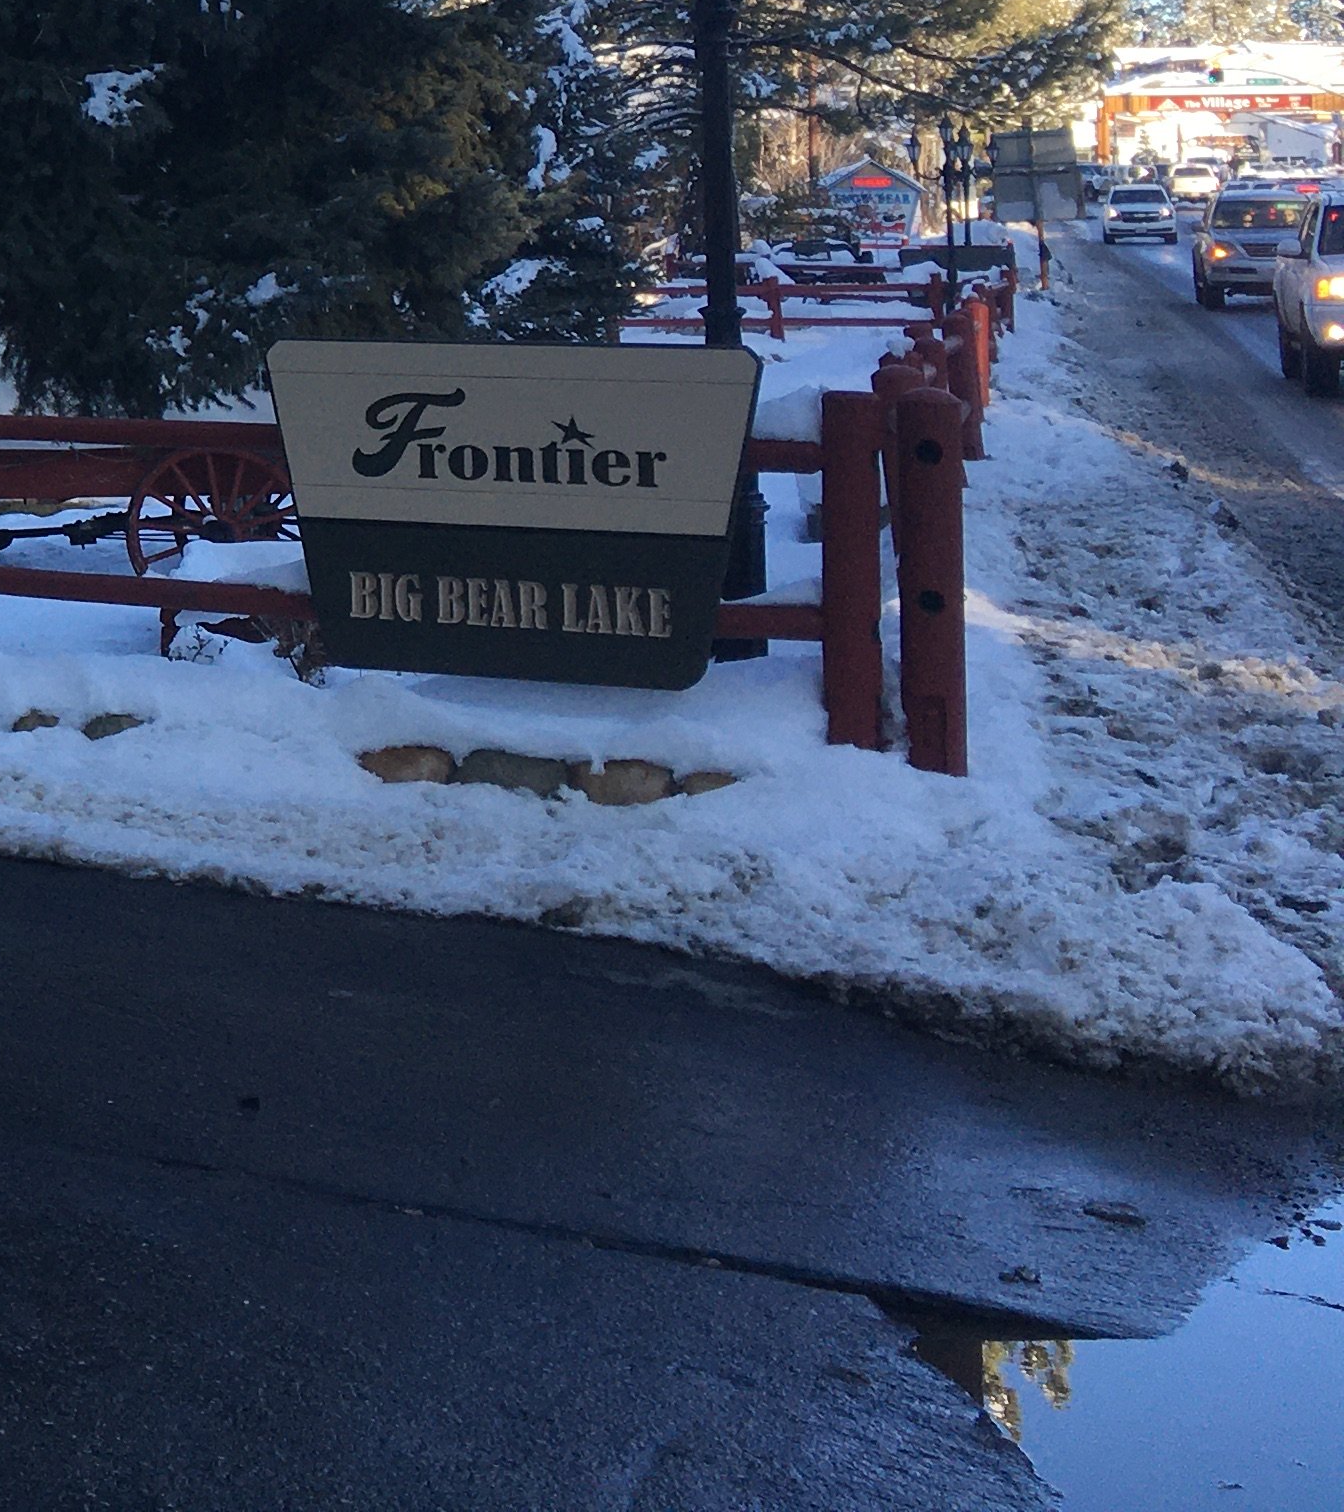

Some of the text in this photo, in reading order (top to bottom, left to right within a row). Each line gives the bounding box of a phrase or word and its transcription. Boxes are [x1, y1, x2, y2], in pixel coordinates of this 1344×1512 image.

[1184, 96, 1251, 110] The Village
[352, 388, 667, 488] Frontier
[349, 570, 673, 638] BIG BEAR LAKE
